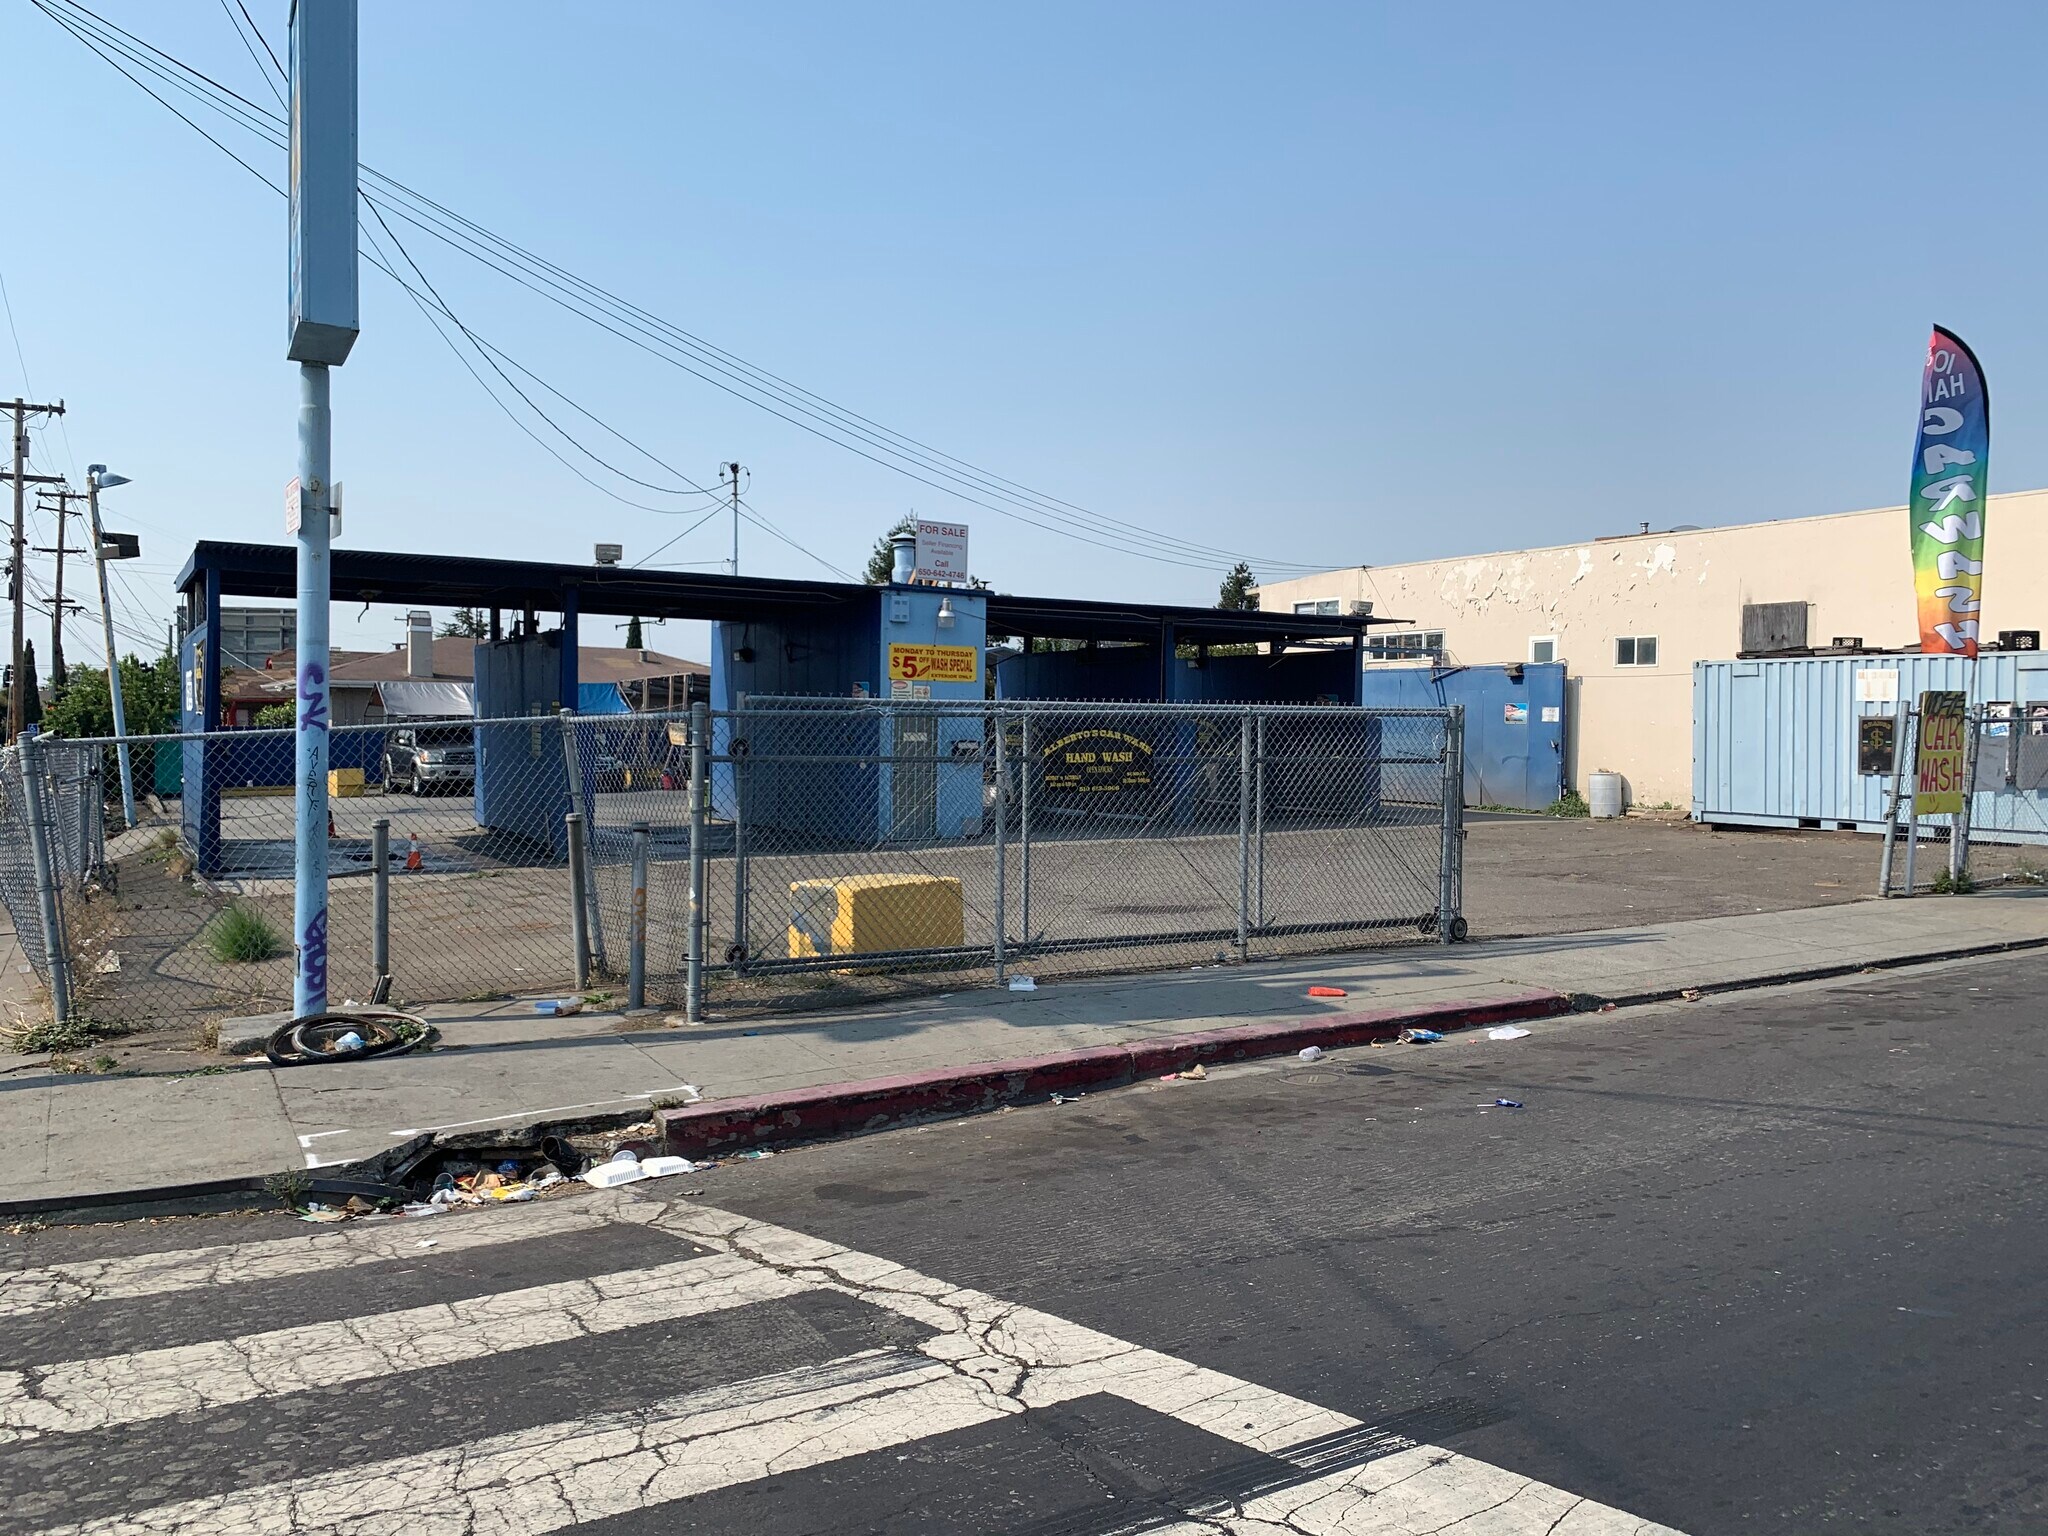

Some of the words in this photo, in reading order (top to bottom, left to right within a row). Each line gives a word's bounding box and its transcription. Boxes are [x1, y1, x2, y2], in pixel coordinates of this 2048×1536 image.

[919, 524, 939, 535] FOR
[941, 526, 966, 538] SALE
[934, 559, 949, 568] Call
[893, 647, 924, 655] MONDAY
[936, 650, 973, 658] THURSDAY
[918, 656, 929, 664] OFF
[930, 657, 948, 671] WASH
[949, 658, 973, 673] SPECIAL
[1100, 730, 1121, 740] CAR
[1923, 713, 1963, 751] CAR
[1065, 752, 1096, 763] HAND
[1102, 751, 1133, 763] WASH
[1919, 756, 1964, 793] WASH
